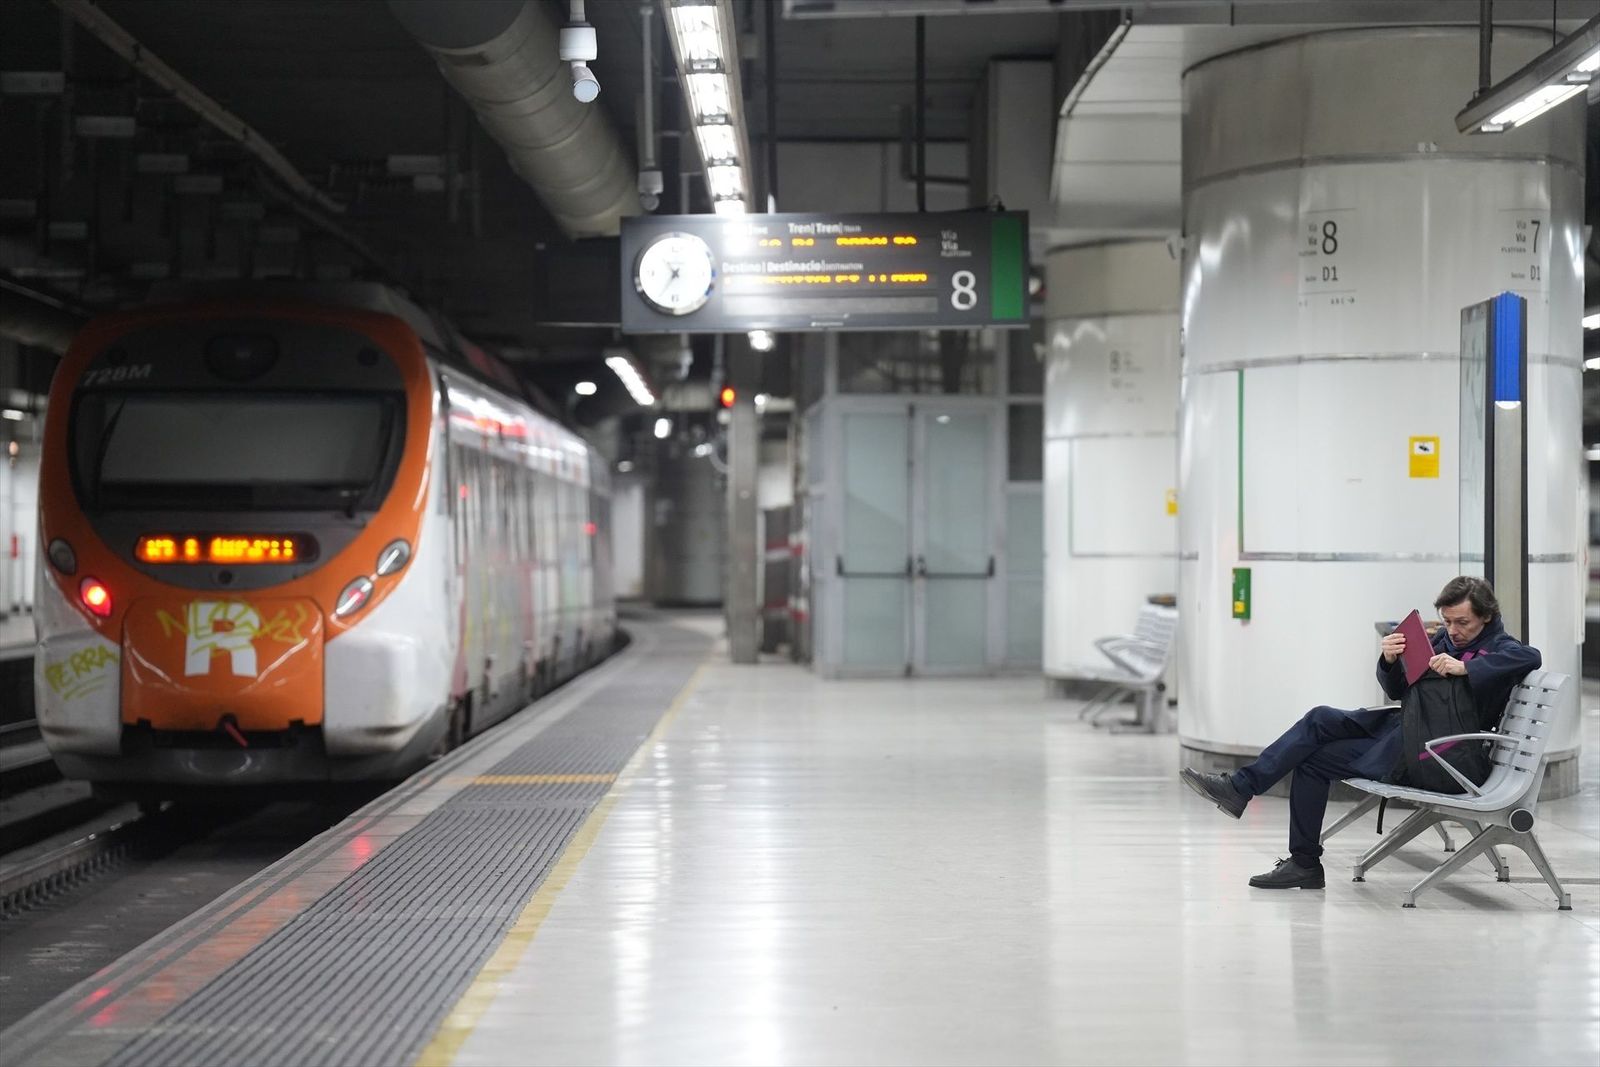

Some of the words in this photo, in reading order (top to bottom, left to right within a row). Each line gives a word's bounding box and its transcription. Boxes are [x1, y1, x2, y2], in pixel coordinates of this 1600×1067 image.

[1322, 221, 1338, 255] 8
[1530, 220, 1541, 253] 7
[1322, 266, 1338, 282] D1
[1530, 265, 1541, 281] D1
[951, 270, 977, 311] 8
[185, 601, 258, 677] R
